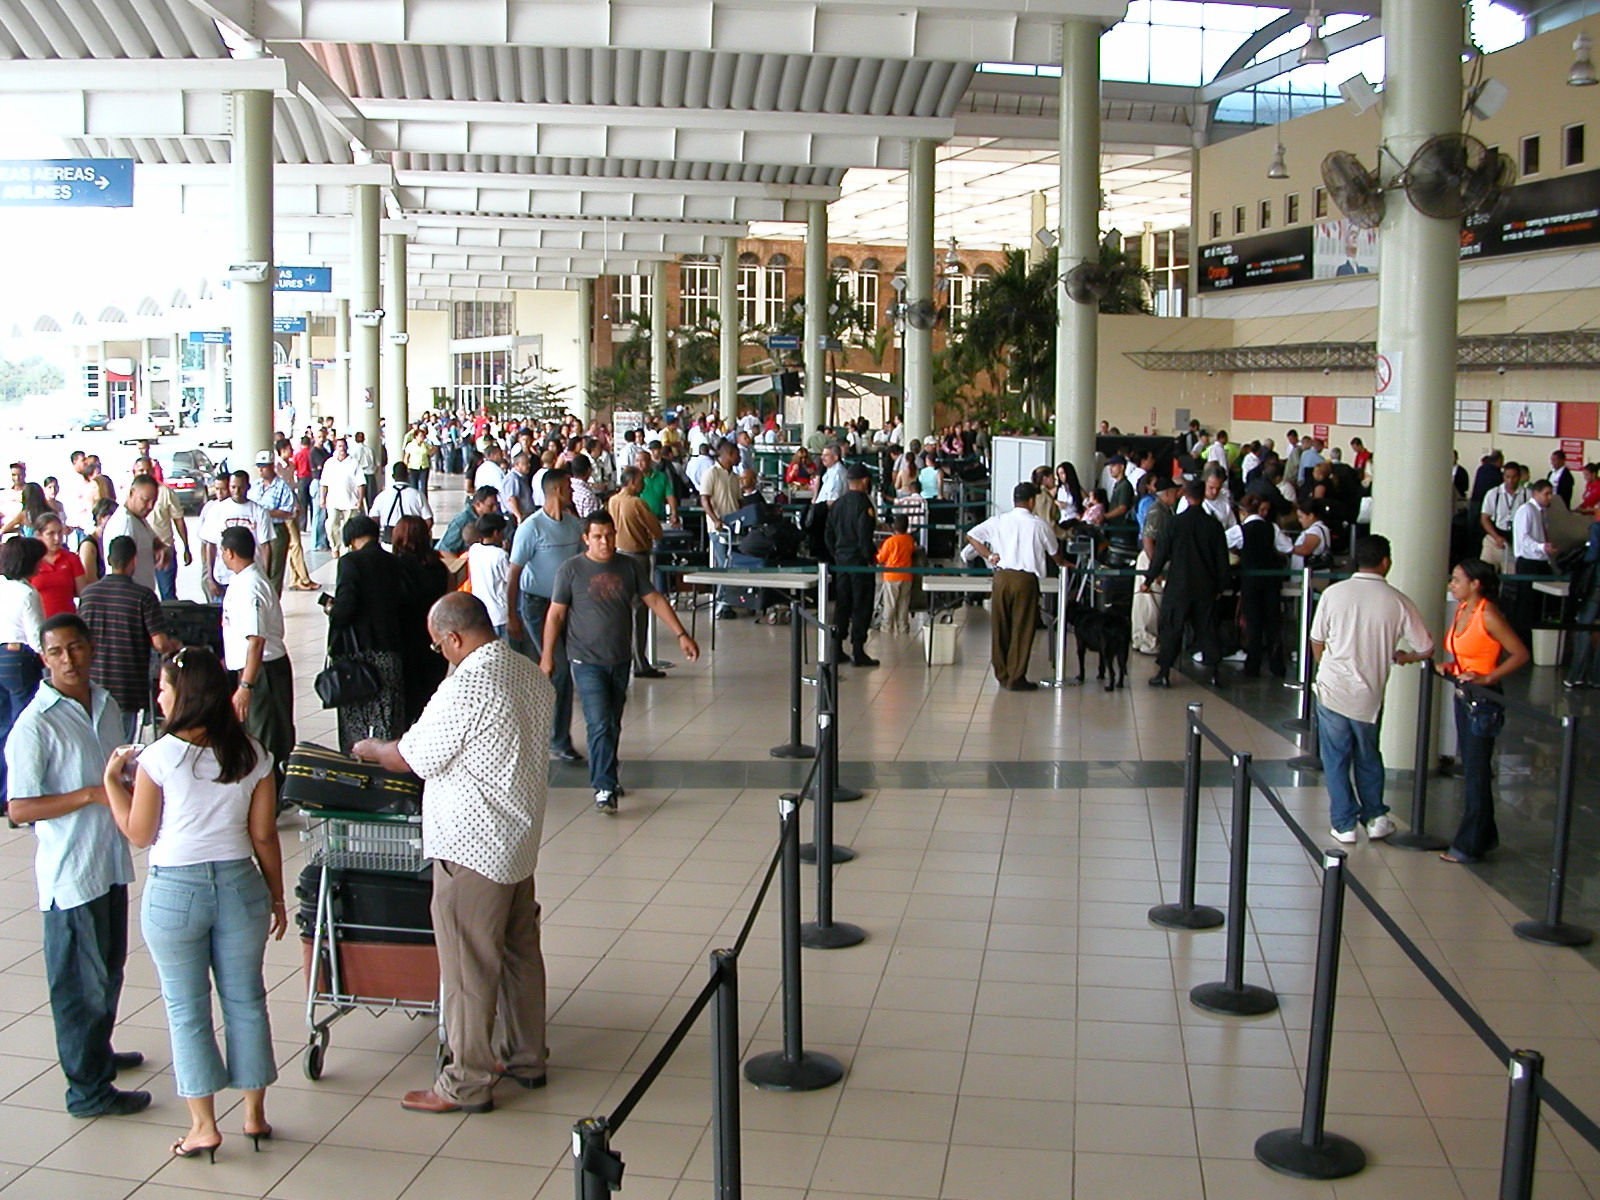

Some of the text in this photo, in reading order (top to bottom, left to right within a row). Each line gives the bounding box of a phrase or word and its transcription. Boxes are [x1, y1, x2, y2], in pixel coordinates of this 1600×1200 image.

[33, 166, 95, 181] AEREAS
[2, 185, 73, 200] AIRLINES
[275, 279, 304, 288] URES
